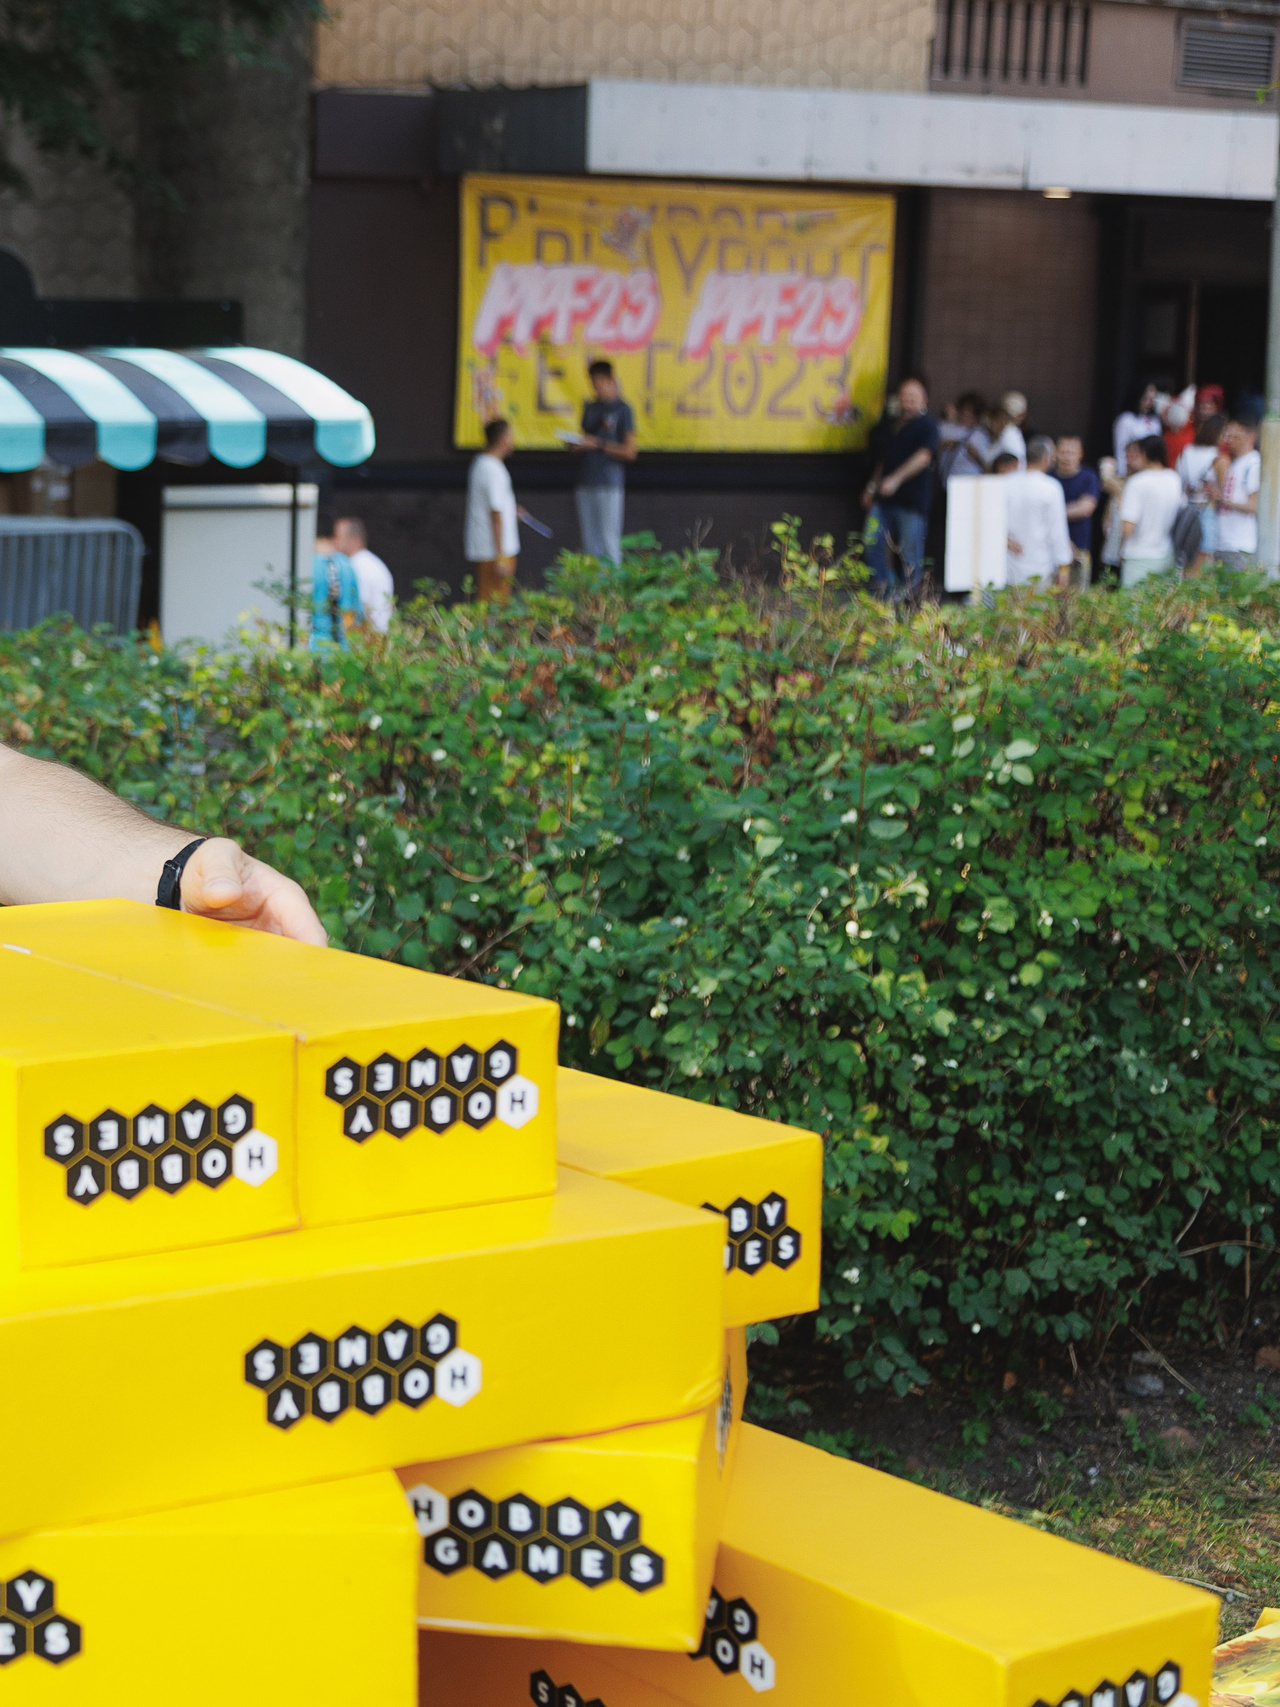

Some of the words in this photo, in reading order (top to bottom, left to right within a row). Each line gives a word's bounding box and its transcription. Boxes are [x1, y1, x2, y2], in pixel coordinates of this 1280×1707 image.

[473, 262, 661, 356] PPF23
[684, 270, 864, 361] PPF23
[331, 1047, 513, 1097] GAMES
[51, 1102, 248, 1157] GAMES
[350, 1088, 528, 1135] HOBBY
[73, 1144, 266, 1198] HOBBY
[251, 1320, 453, 1383] GAMES
[272, 1363, 470, 1424] HOBBY
[412, 1495, 636, 1545] HOBBY
[431, 1535, 657, 1586] GAMES
[1060, 1668, 1179, 1707] GAM
